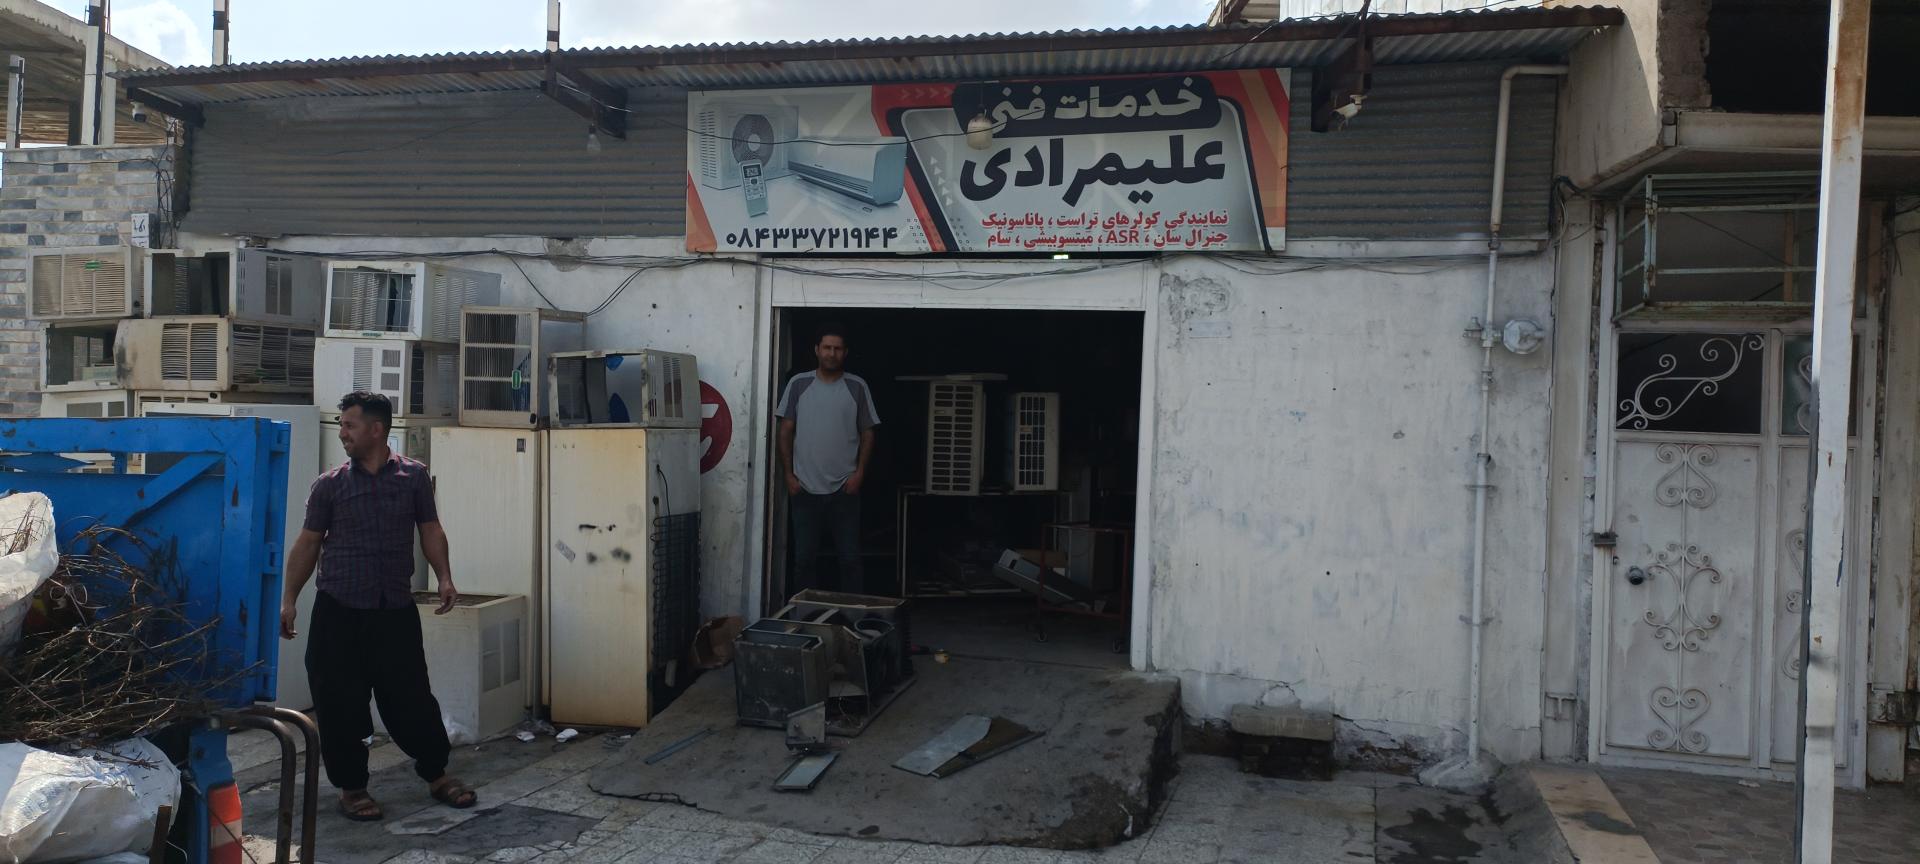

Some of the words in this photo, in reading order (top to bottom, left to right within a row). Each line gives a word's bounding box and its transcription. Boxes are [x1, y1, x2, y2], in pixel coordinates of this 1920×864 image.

[1053, 76, 1202, 120] خدمات
[991, 85, 1046, 138] فنی
[959, 134, 1226, 208] علیمرادی
[981, 212, 1044, 231] پاناسونیک
[1056, 212, 1099, 230] تراست
[1101, 210, 1161, 230] کولرهای
[1164, 210, 1228, 229] نمایندگی
[726, 227, 898, 249] ۰۸۴۳۳۷۲۱۹۴۴
[1105, 229, 1140, 244] ASR
[1153, 229, 1182, 248] سان
[1185, 228, 1228, 248] جنرال
